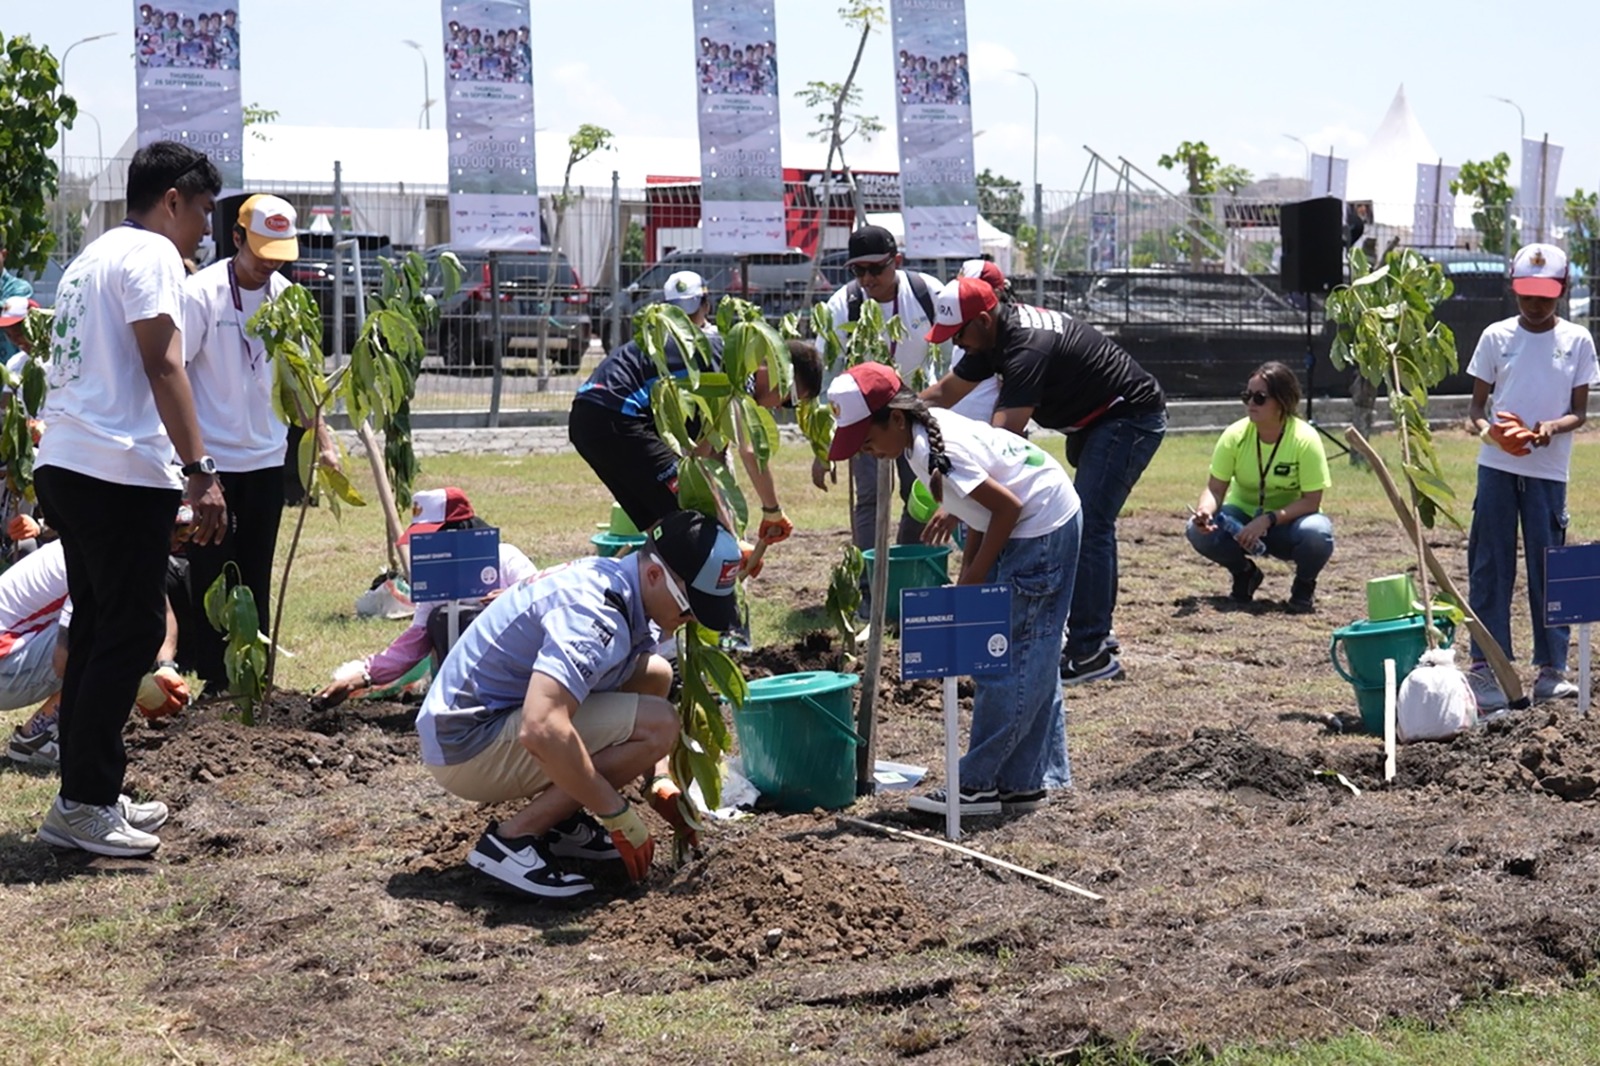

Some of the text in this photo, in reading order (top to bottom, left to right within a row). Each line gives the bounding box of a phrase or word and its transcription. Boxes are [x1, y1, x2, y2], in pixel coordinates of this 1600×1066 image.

[162, 131, 221, 145] ROAD TO
[468, 142, 517, 154] ROAD TO
[718, 151, 766, 162] ROAD TO
[499, 156, 534, 169] TREES
[947, 159, 960, 170] TO
[747, 165, 780, 177] TREES
[944, 172, 973, 183] TREES
[905, 616, 926, 624] MANUEL
